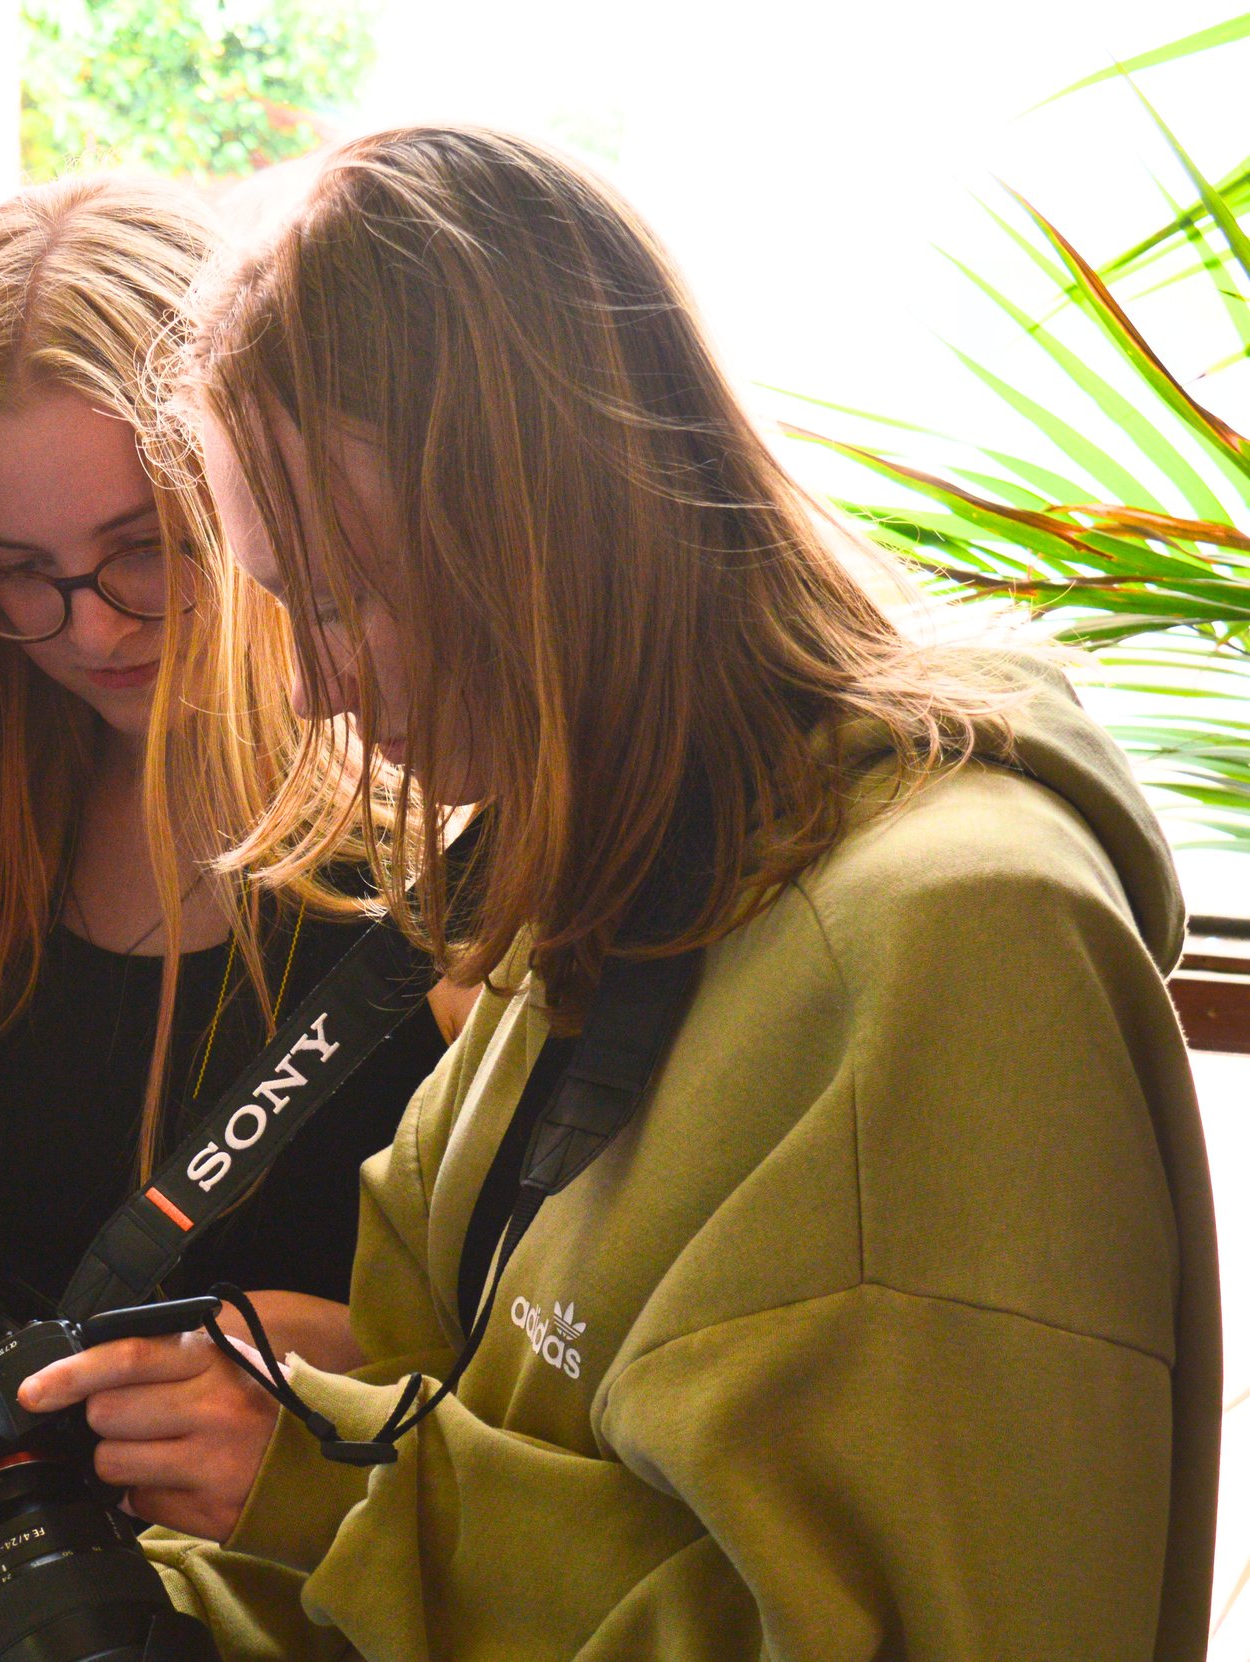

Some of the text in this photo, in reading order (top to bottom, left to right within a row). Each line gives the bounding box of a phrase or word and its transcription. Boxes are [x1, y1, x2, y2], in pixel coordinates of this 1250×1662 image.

[186, 1012, 341, 1193] SONY
[511, 1296, 581, 1380] adidas
[32, 1526, 46, 1539] FE
